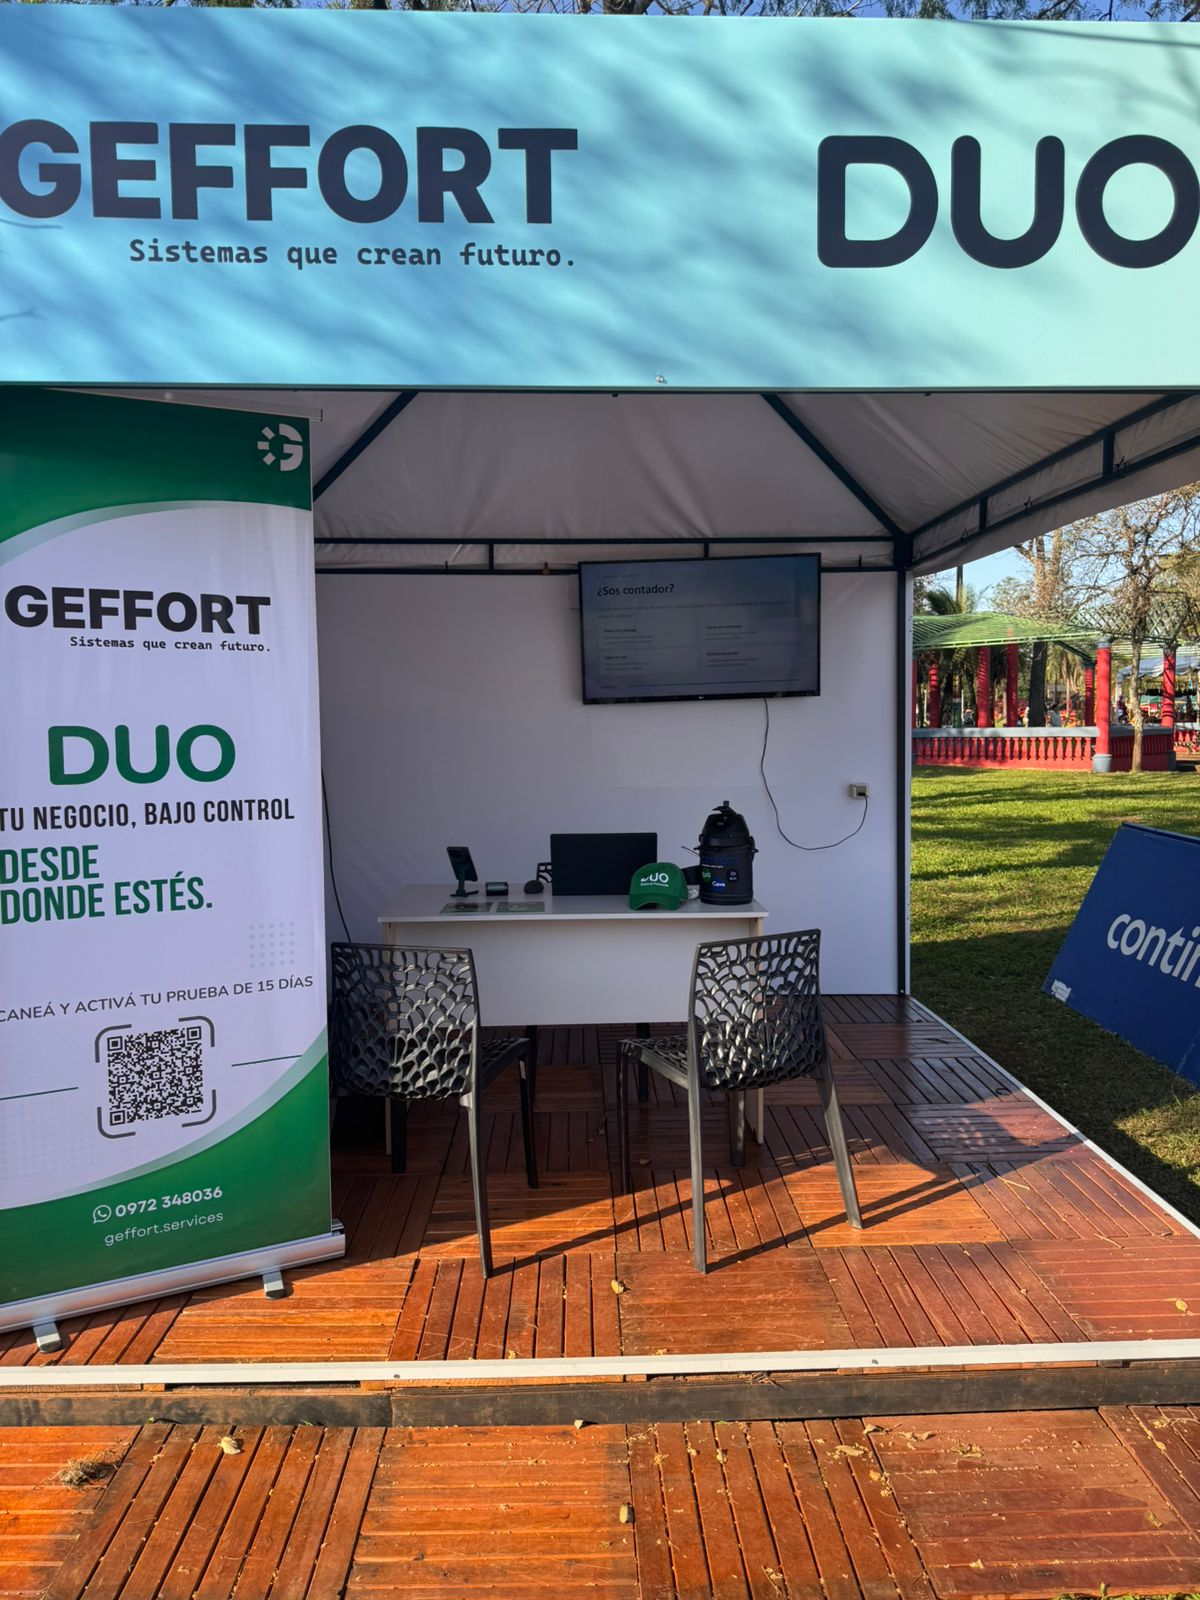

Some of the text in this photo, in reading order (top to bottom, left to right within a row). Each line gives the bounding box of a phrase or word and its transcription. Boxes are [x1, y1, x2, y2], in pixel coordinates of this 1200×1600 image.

[0, 118, 579, 225] GEFFORT
[816, 134, 1200, 270] DUO
[129, 238, 575, 271] Sistemas que crean futuro.
[4, 585, 271, 635] GEFFORT
[597, 583, 675, 597] ¿Sos contador?
[70, 635, 270, 652] Sistemas que crean futuro.
[47, 724, 236, 786] DUO
[0, 798, 295, 832] TU NEGOCIO, BAJO CONTROL
[0, 844, 100, 885] DESDE
[0, 871, 213, 925] DONDE ESTÉS.
[59, 1002, 71, 1015] Y
[74, 992, 137, 1014] ACTIVÁ
[139, 992, 162, 1006] TU
[166, 985, 229, 1003] PRUEBA
[233, 982, 253, 995] DE
[257, 979, 275, 993] 15
[278, 974, 314, 990] DÍAS
[115, 1186, 223, 1218] 0972 348036
[104, 1211, 224, 1247] geffort.services
